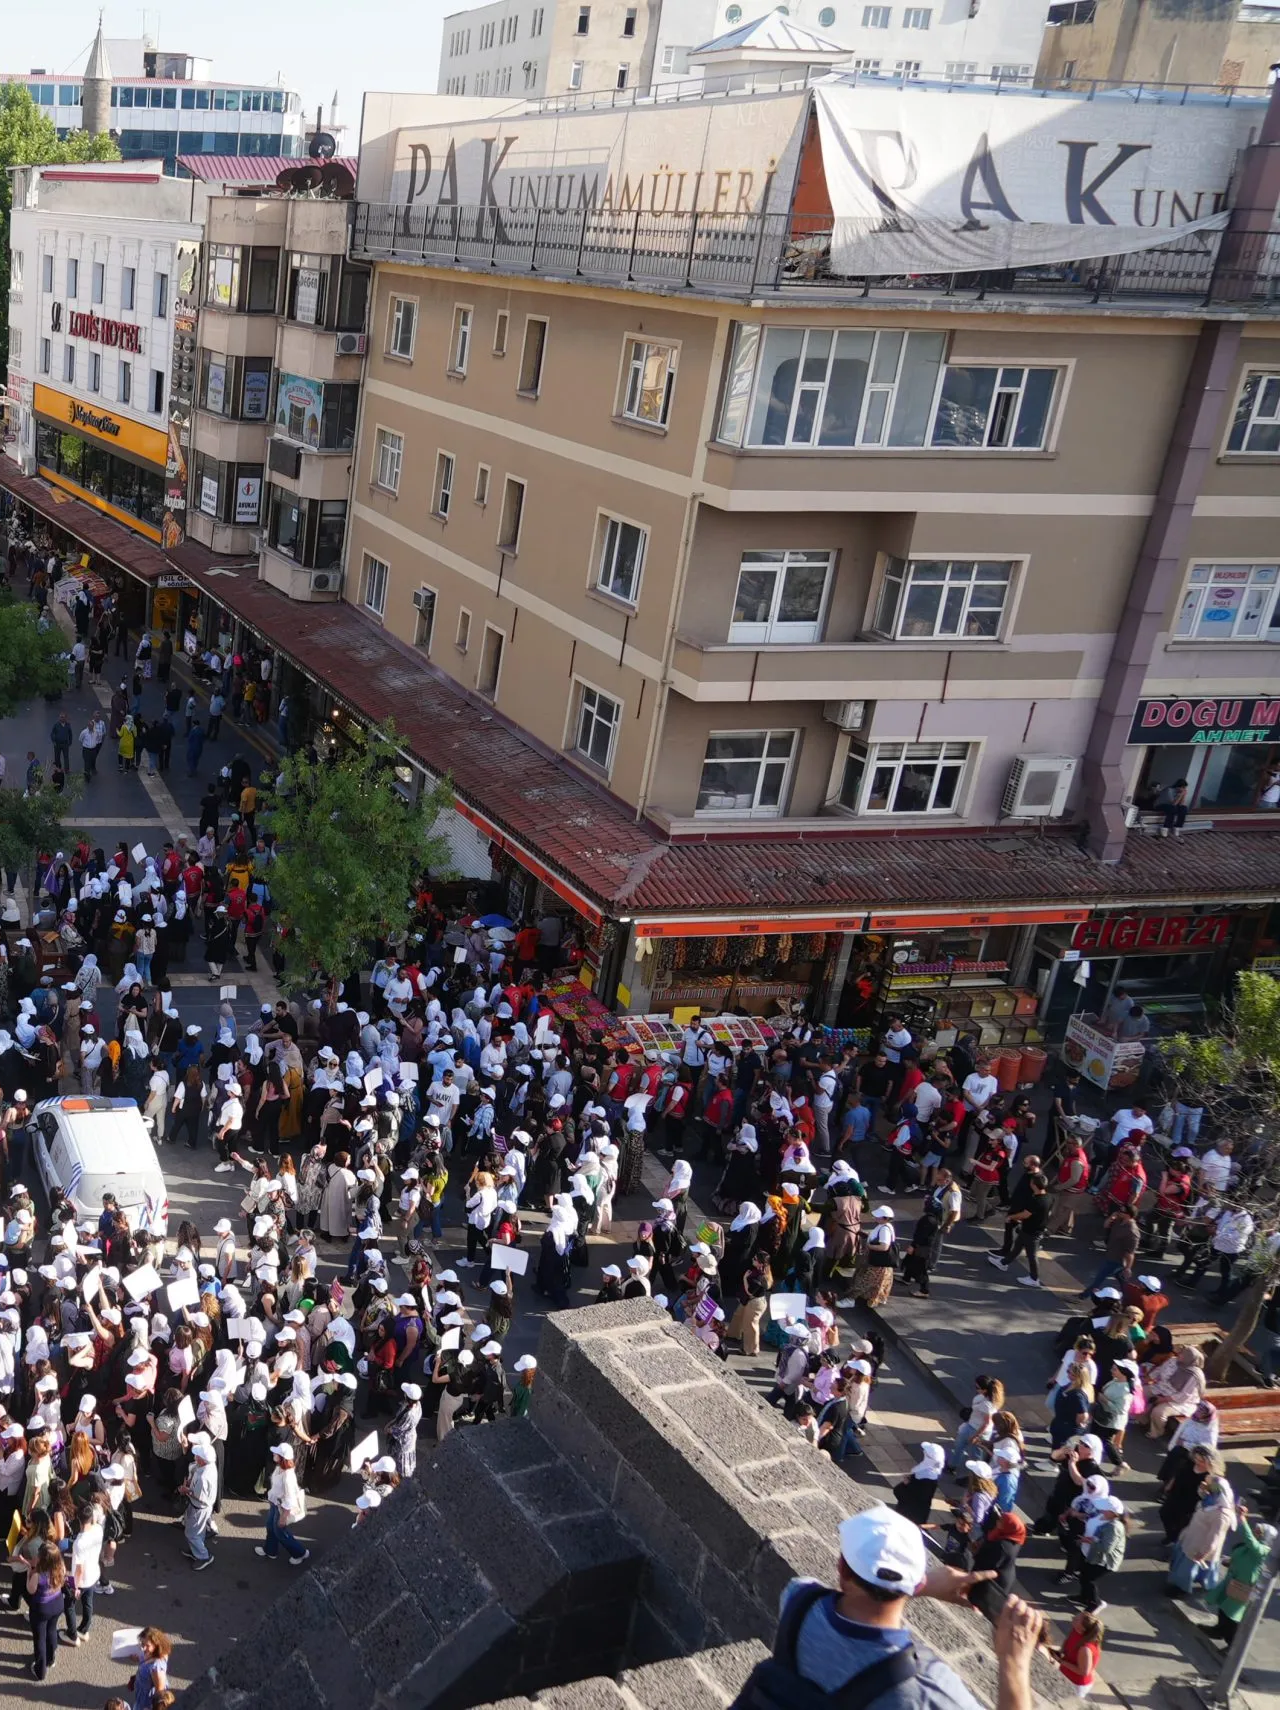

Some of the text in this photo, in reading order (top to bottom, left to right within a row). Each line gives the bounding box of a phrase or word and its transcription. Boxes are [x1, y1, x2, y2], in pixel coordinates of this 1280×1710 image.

[100, 317, 142, 354] HOTEL
[1141, 700, 1280, 728] DOĞU M
[1189, 729, 1270, 743] AHMET
[1187, 916, 1230, 945] 21
